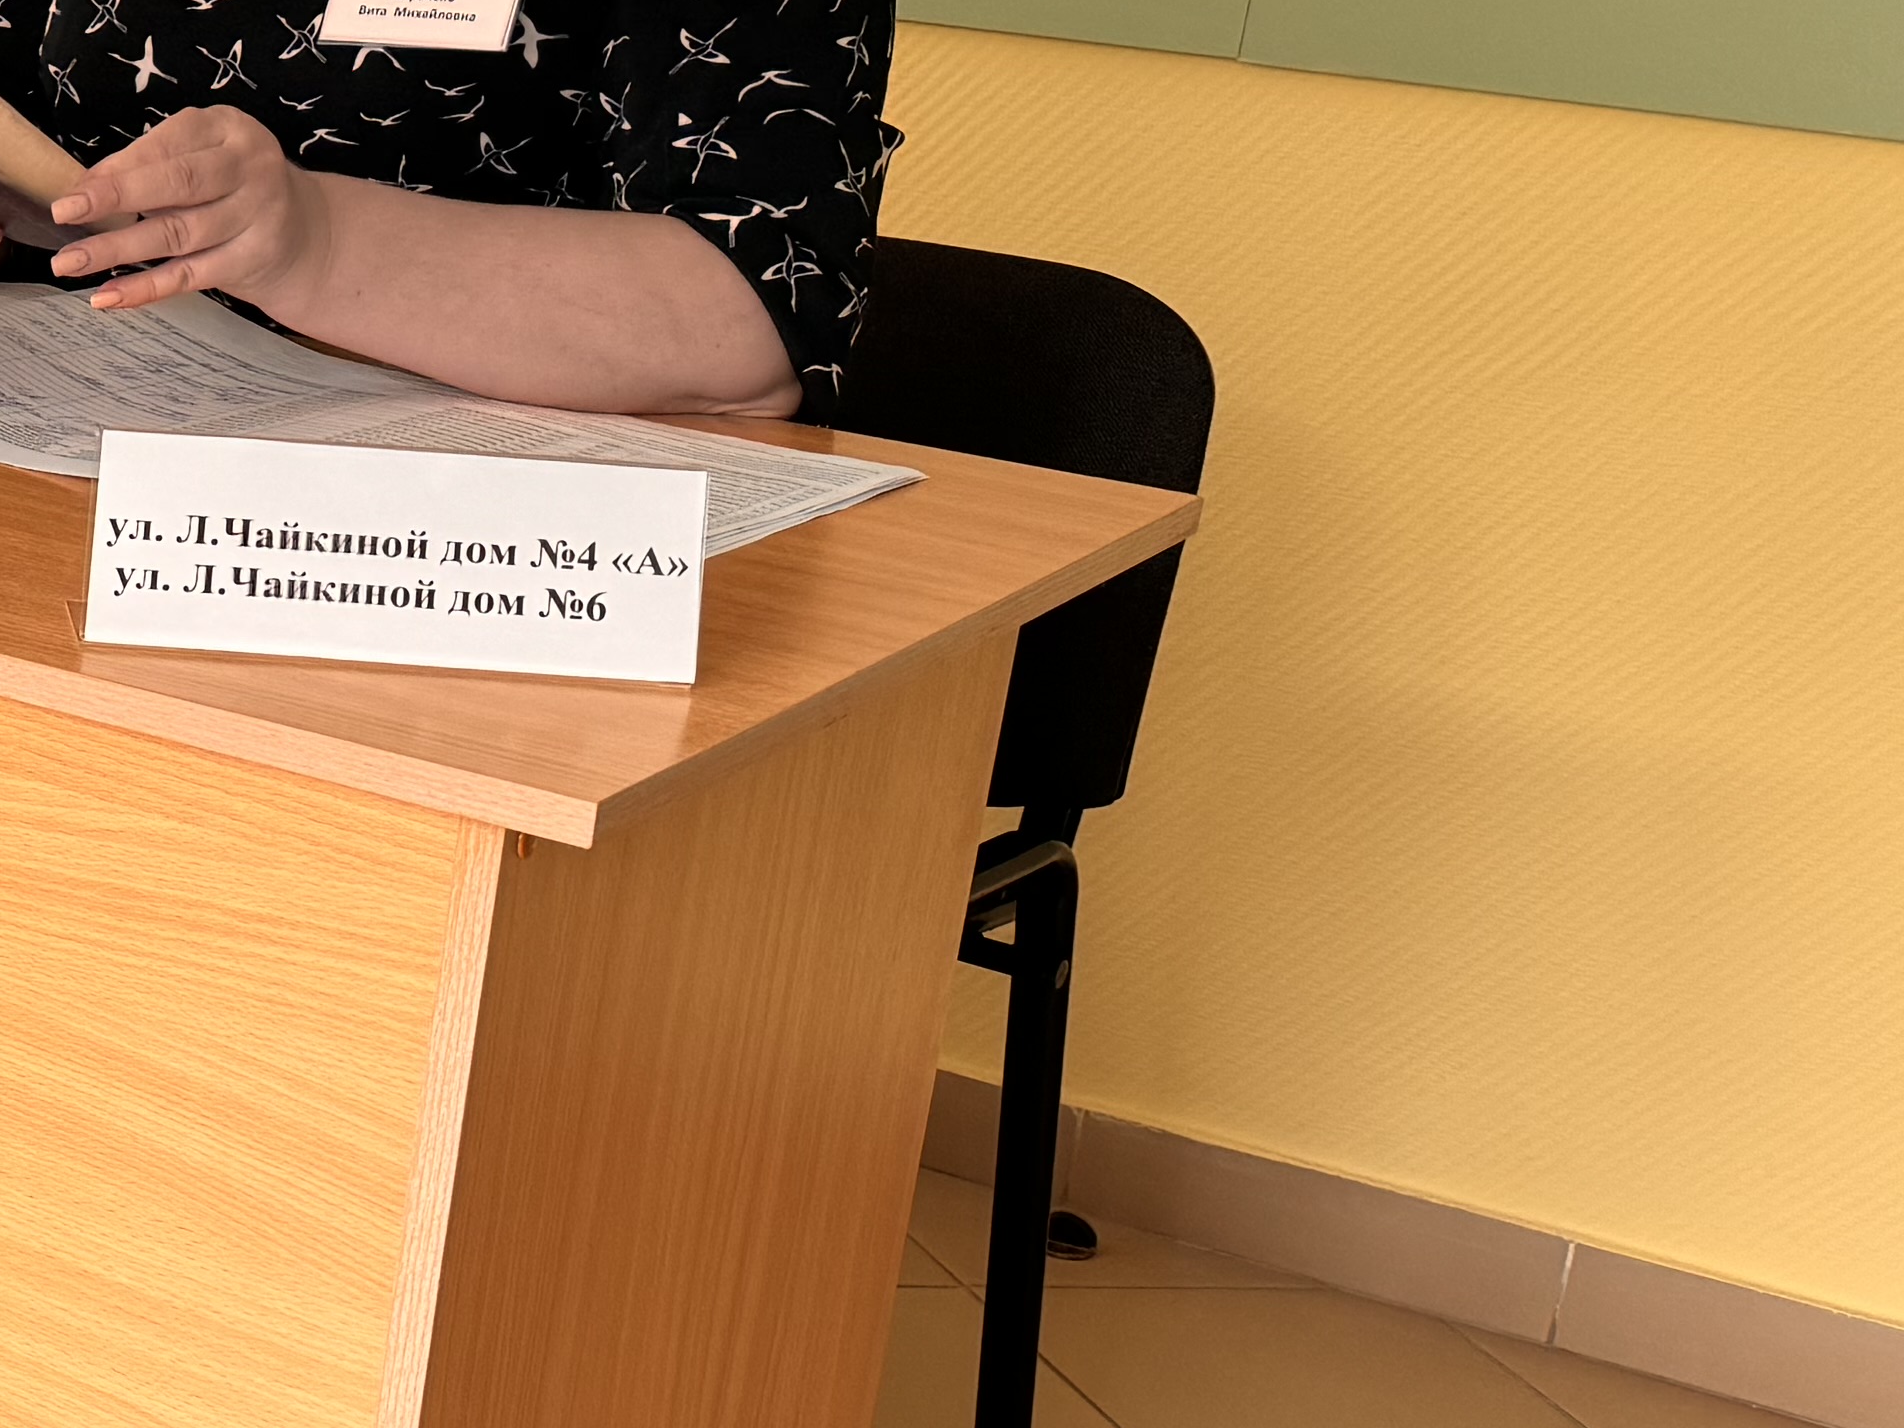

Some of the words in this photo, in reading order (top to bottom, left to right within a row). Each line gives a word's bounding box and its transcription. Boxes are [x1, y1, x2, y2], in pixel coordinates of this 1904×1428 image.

[358, 4, 387, 16] Вита
[393, 6, 477, 22] Михайловна
[106, 517, 164, 547] ул.
[176, 514, 429, 560] Л.Чайкиной
[439, 540, 518, 567] дом
[530, 538, 598, 572] №4
[611, 546, 690, 578] «А»
[113, 566, 171, 597] ул.
[183, 563, 437, 610] Л.Чайкиной
[448, 590, 526, 617] дом
[538, 587, 609, 622] №6
